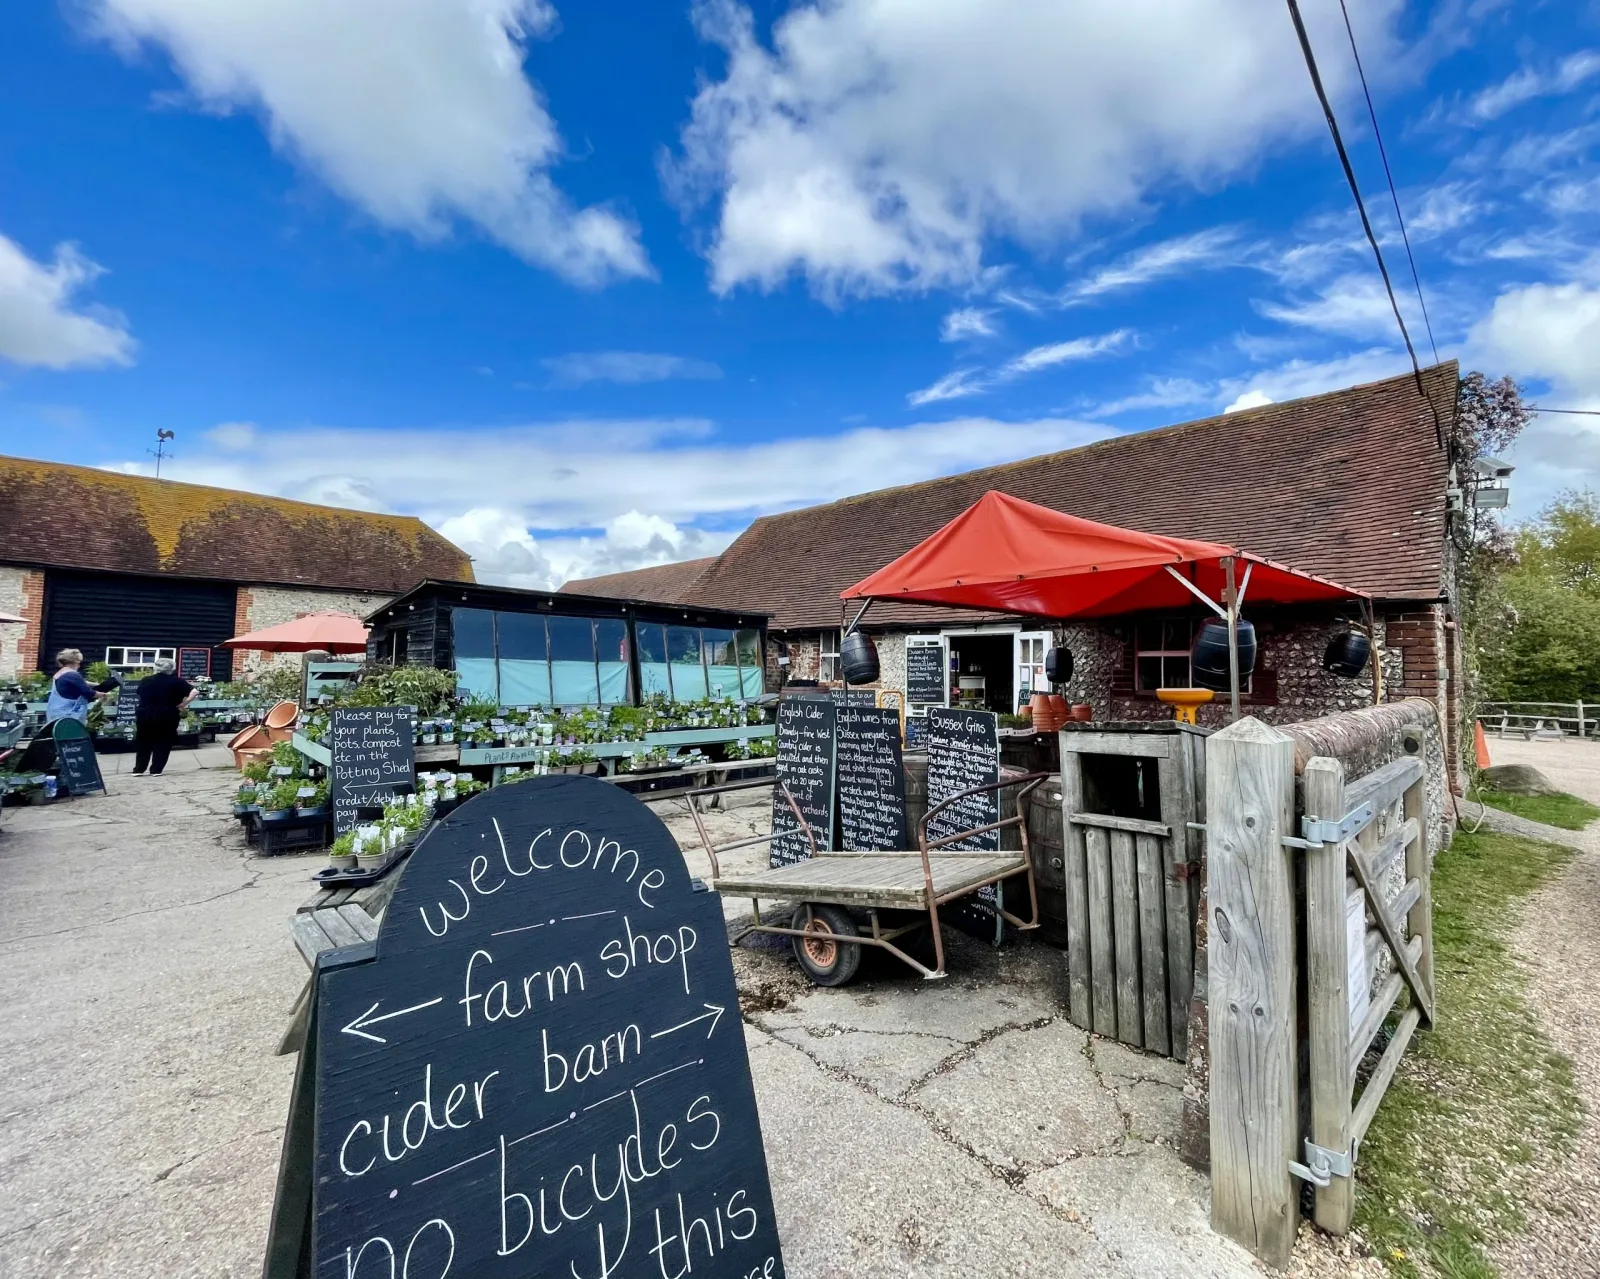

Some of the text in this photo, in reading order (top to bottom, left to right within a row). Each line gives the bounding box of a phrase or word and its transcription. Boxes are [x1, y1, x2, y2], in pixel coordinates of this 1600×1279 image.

[376, 712, 394, 726] pay
[395, 708, 410, 720] for
[780, 703, 824, 724] English Cider
[836, 709, 861, 731] English
[862, 712, 880, 724] wines
[881, 710, 899, 725] from
[931, 709, 986, 735] Sussex Gins
[334, 726, 357, 740] your
[816, 728, 831, 739] West
[836, 725, 860, 740] Sussex
[362, 737, 402, 753] compost
[815, 744, 822, 752] is
[356, 753, 365, 761] in
[369, 751, 389, 761] the
[802, 754, 814, 764] and
[335, 759, 411, 784] Potting Shed
[792, 776, 799, 785] to
[800, 777, 808, 786] 20
[802, 804, 829, 817] orchards
[420, 818, 665, 936] welcome
[459, 916, 697, 1026] farm shop
[340, 1024, 642, 1176] cider barn
[648, 1190, 757, 1279] this
[345, 1218, 455, 1279] no
